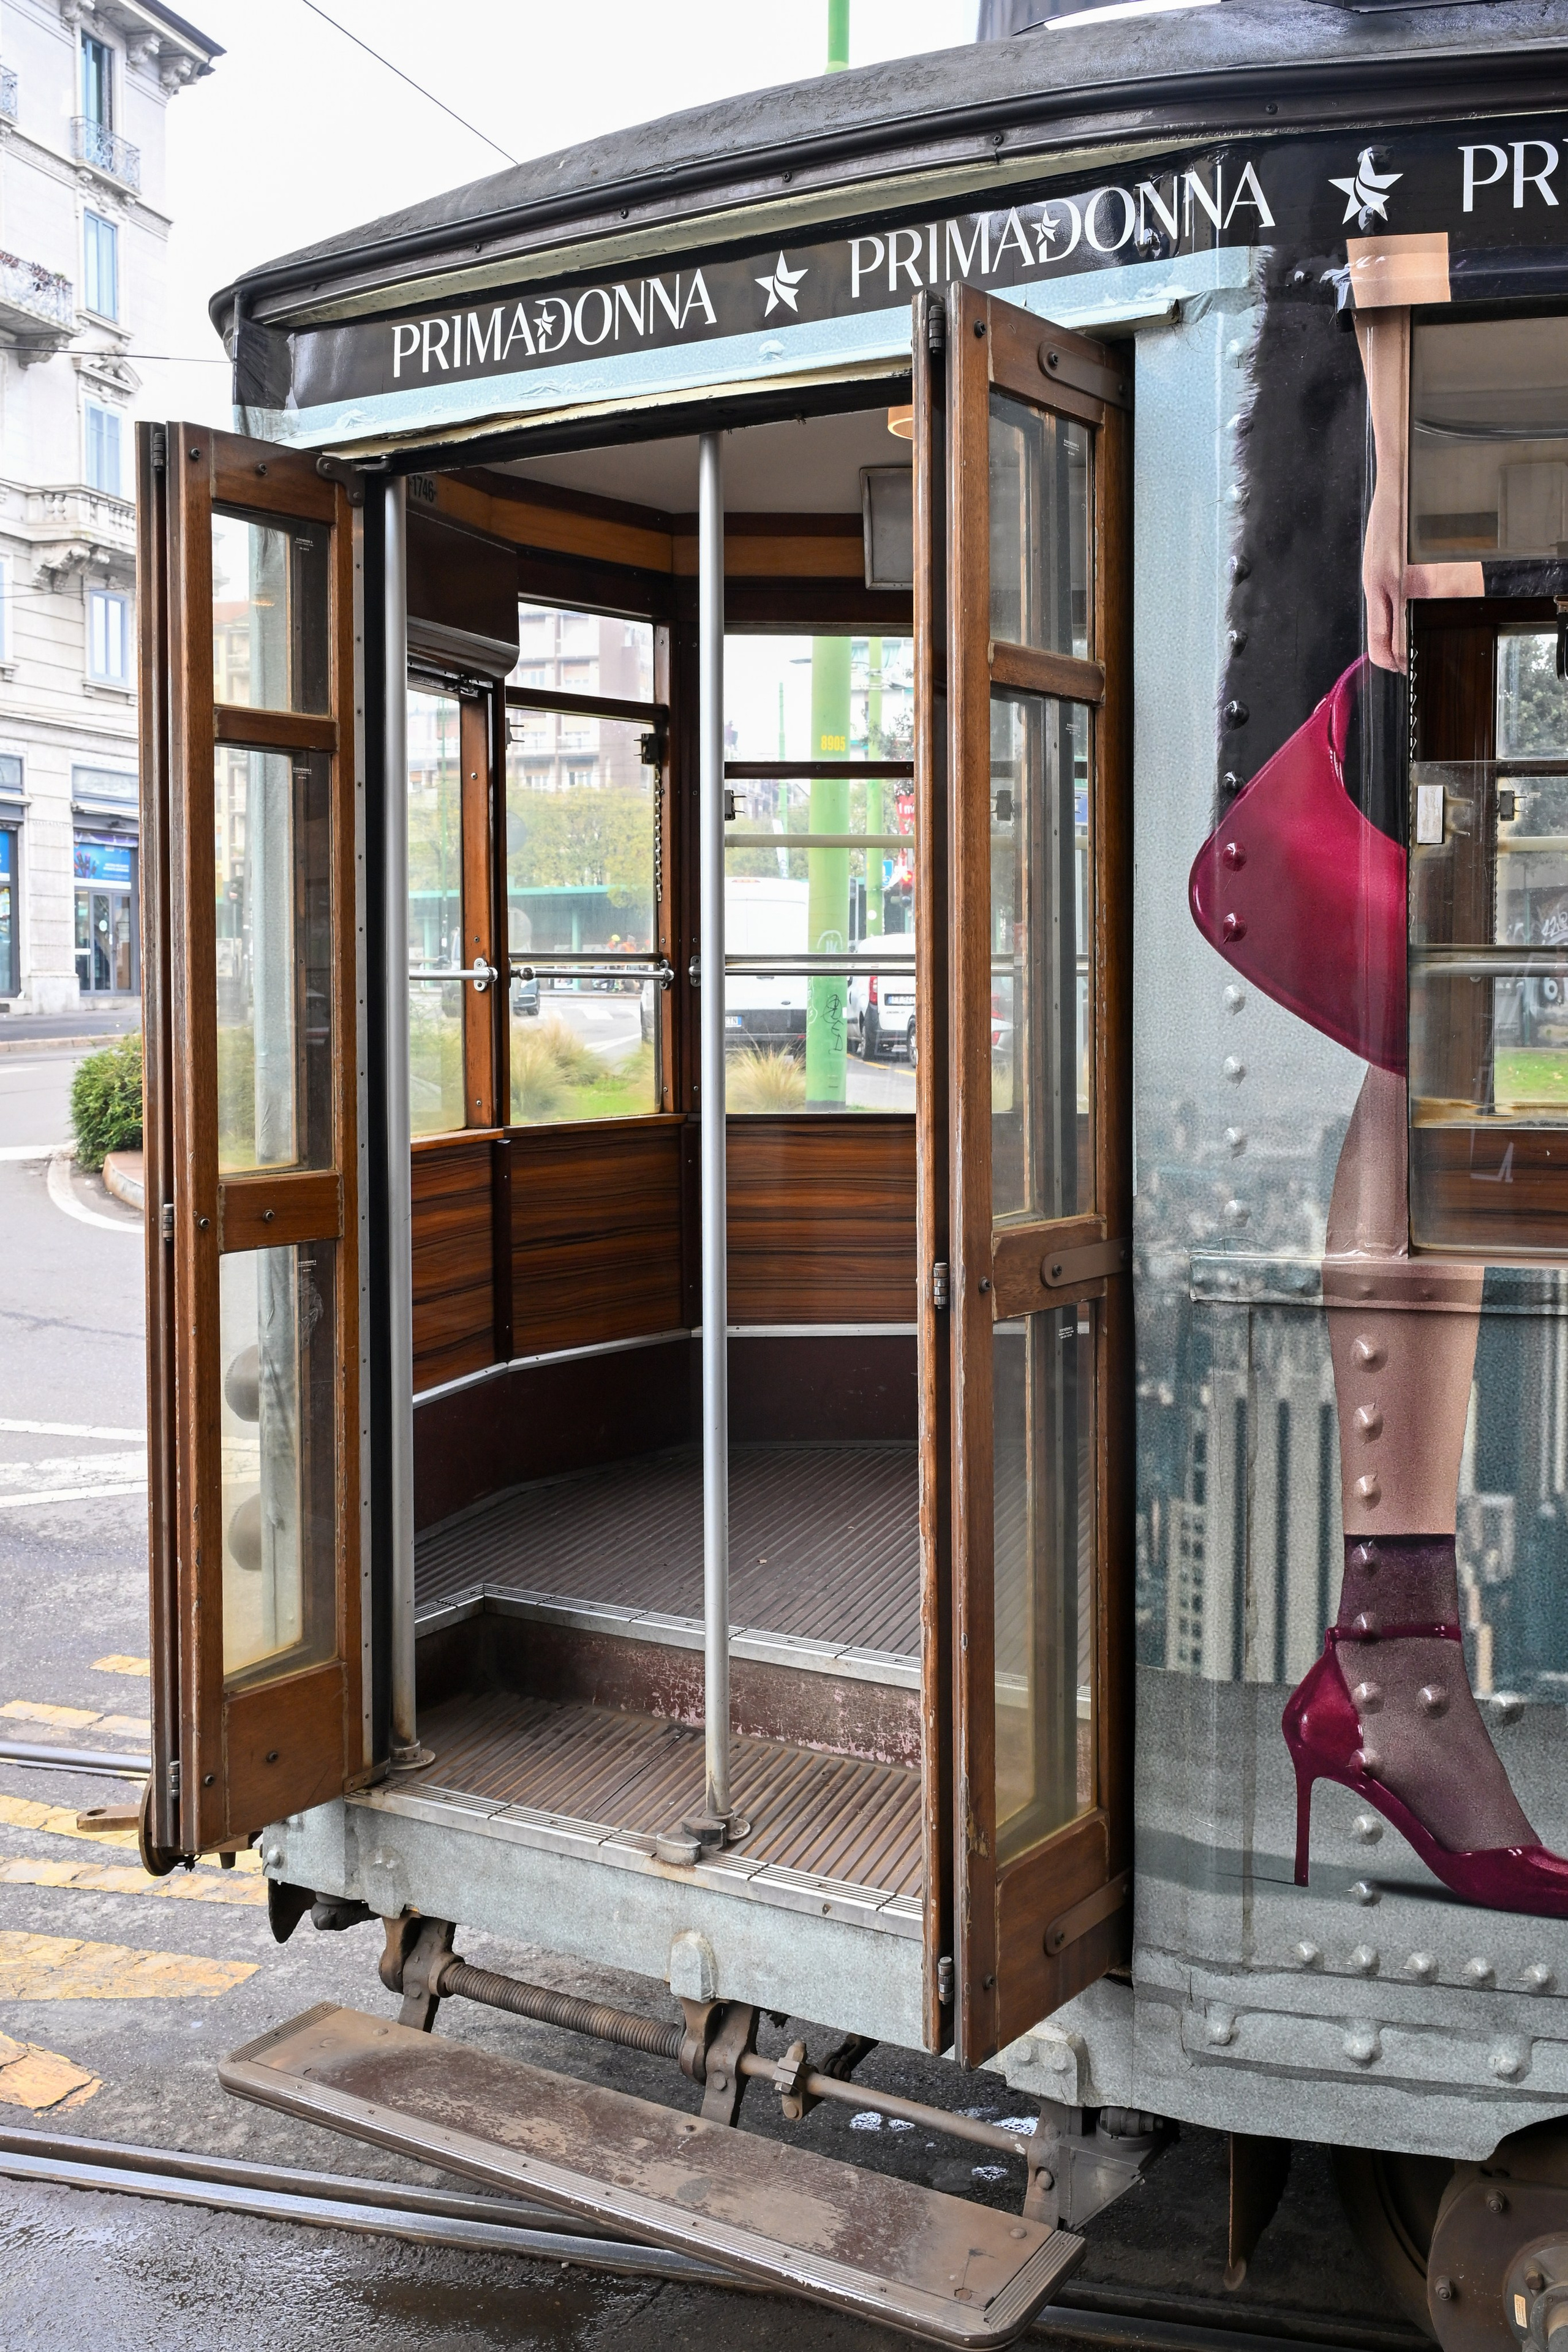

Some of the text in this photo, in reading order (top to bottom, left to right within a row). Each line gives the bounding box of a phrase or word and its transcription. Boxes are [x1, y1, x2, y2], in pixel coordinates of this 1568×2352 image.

[1458, 138, 1568, 212] PR
[848, 162, 1276, 298] PRIMADONNA
[392, 269, 717, 378] PRIMADONNA
[821, 734, 846, 752] 8905
